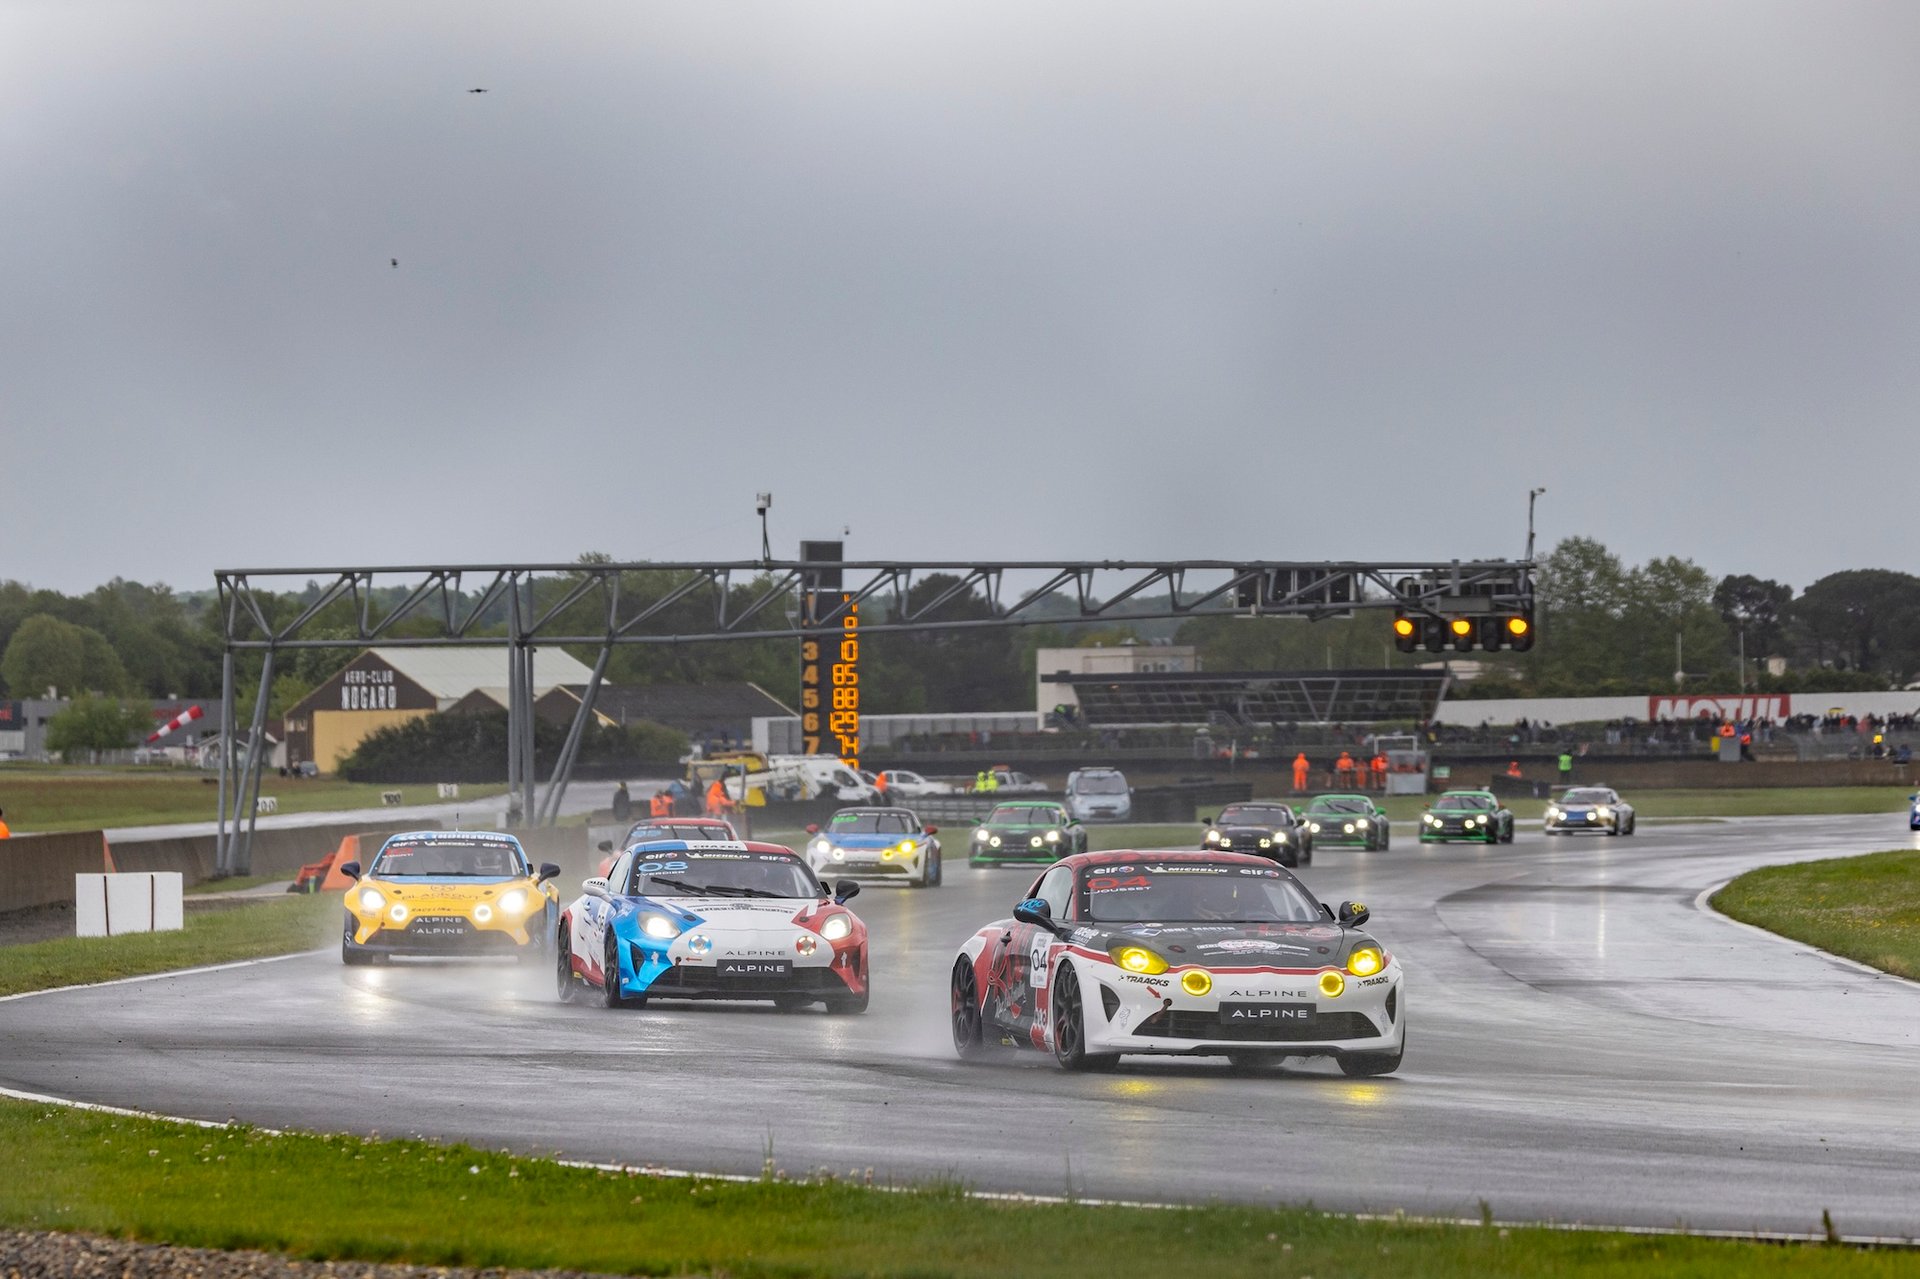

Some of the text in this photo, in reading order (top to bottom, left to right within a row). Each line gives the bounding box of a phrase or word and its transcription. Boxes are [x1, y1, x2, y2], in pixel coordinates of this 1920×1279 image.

[802, 641, 818, 661] 3
[344, 669, 394, 684] AERO-CLUB
[802, 663, 859, 686] 4 85
[341, 685, 397, 710] NOGARO
[802, 687, 859, 710] 5 88
[1656, 697, 1790, 727] MOTUL
[803, 712, 819, 733] 6
[803, 735, 820, 756] 7
[703, 852, 751, 860] MICHELIN
[638, 861, 689, 873] 08
[1093, 866, 1118, 874] elf
[1167, 866, 1229, 874] MICHELIN
[1087, 875, 1152, 890] 04
[1031, 948, 1048, 973] 04
[725, 964, 785, 973] ALPINE
[1126, 974, 1170, 987] TRAACKS
[1362, 976, 1389, 987] TRAACKS
[1228, 990, 1308, 998] ALPINE
[1231, 1009, 1308, 1019] ALPINE
